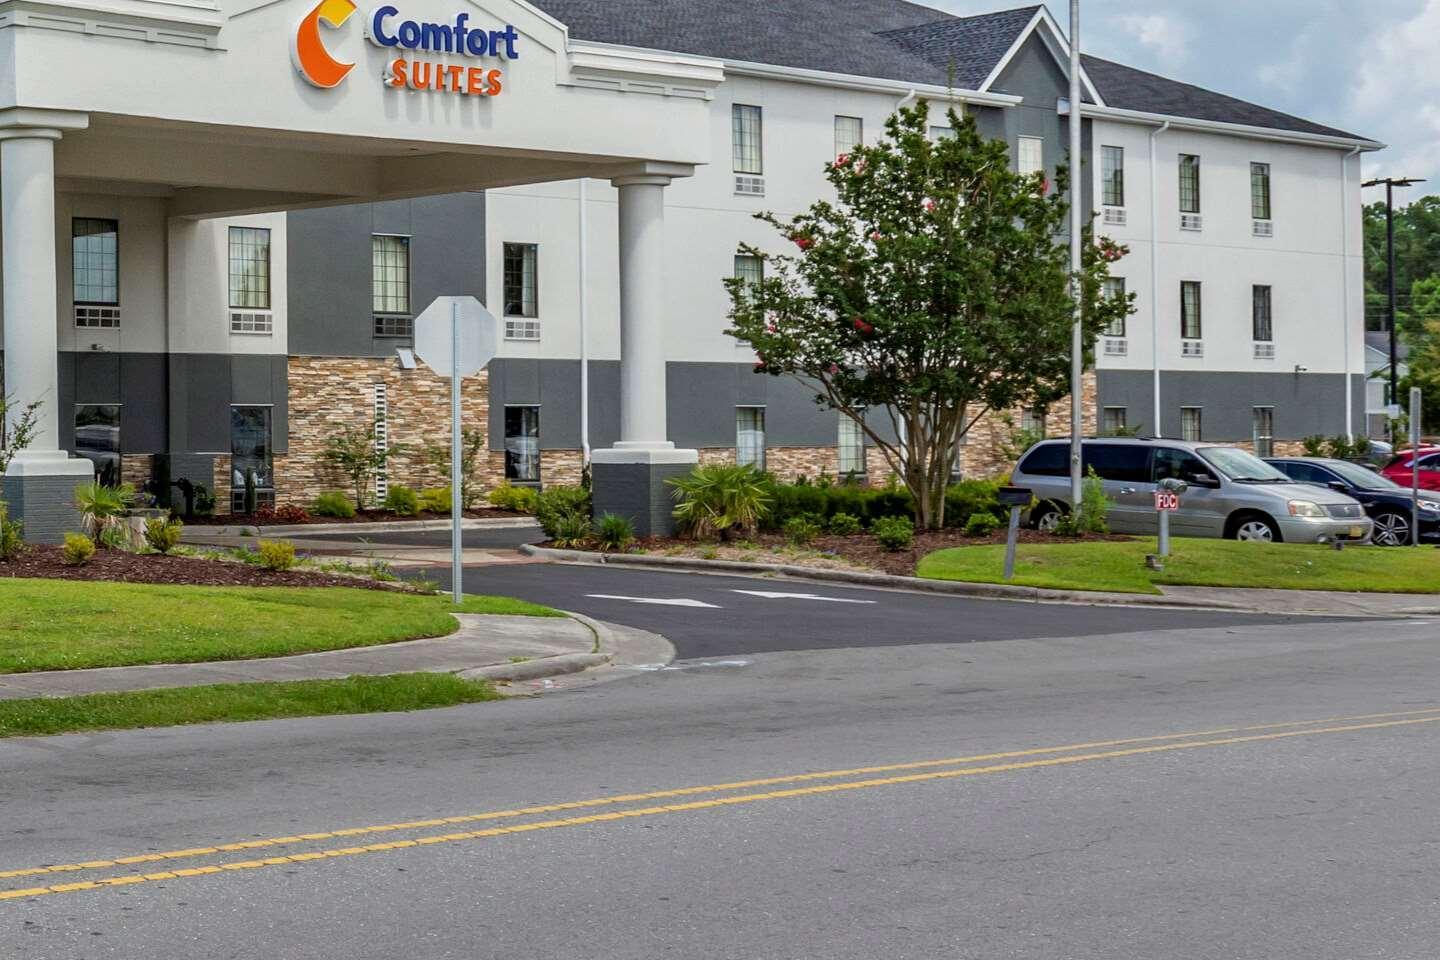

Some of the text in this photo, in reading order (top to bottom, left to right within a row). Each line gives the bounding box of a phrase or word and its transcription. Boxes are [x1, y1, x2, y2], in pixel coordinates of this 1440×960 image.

[372, 5, 519, 60] Comfort
[391, 58, 502, 97] SUITES
[1157, 494, 1176, 508] FDC
